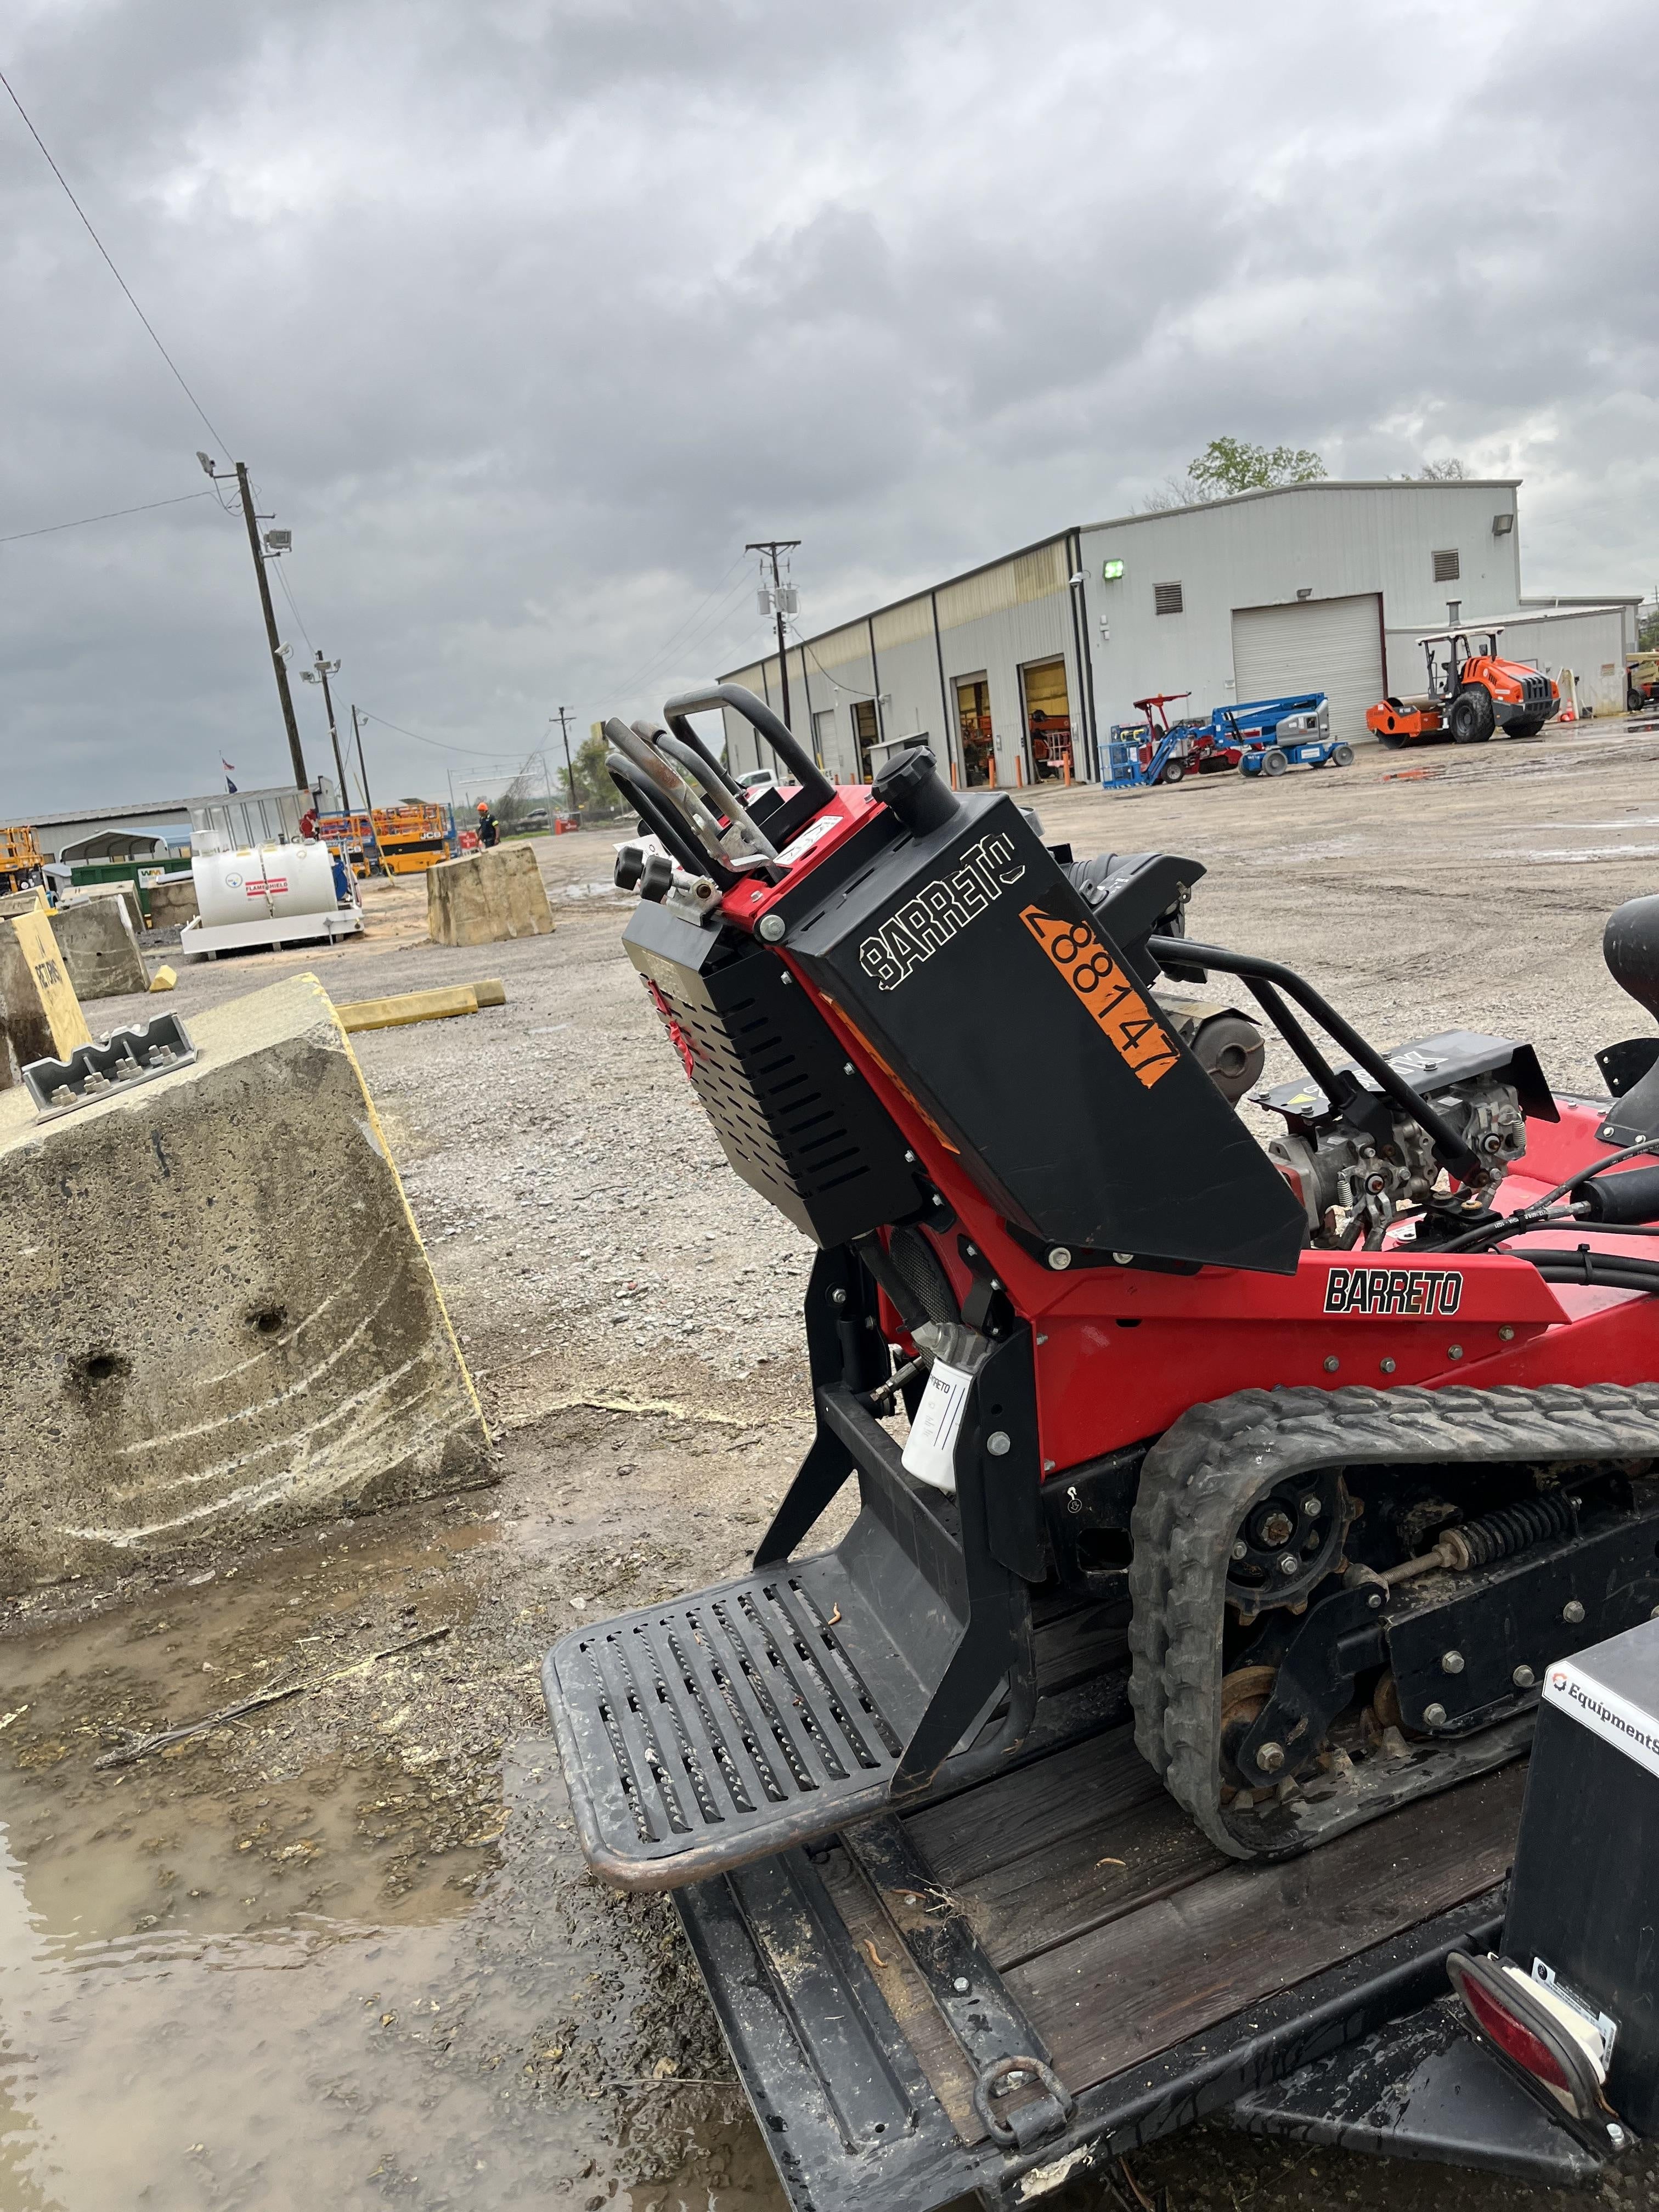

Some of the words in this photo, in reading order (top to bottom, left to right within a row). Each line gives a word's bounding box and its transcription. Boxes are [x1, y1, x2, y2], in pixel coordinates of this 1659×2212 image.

[420, 831, 442, 840] JCB
[860, 832, 1025, 990] BARRETO
[1025, 913, 1180, 1071] 288147
[1323, 1268, 1464, 1316] BARRETO
